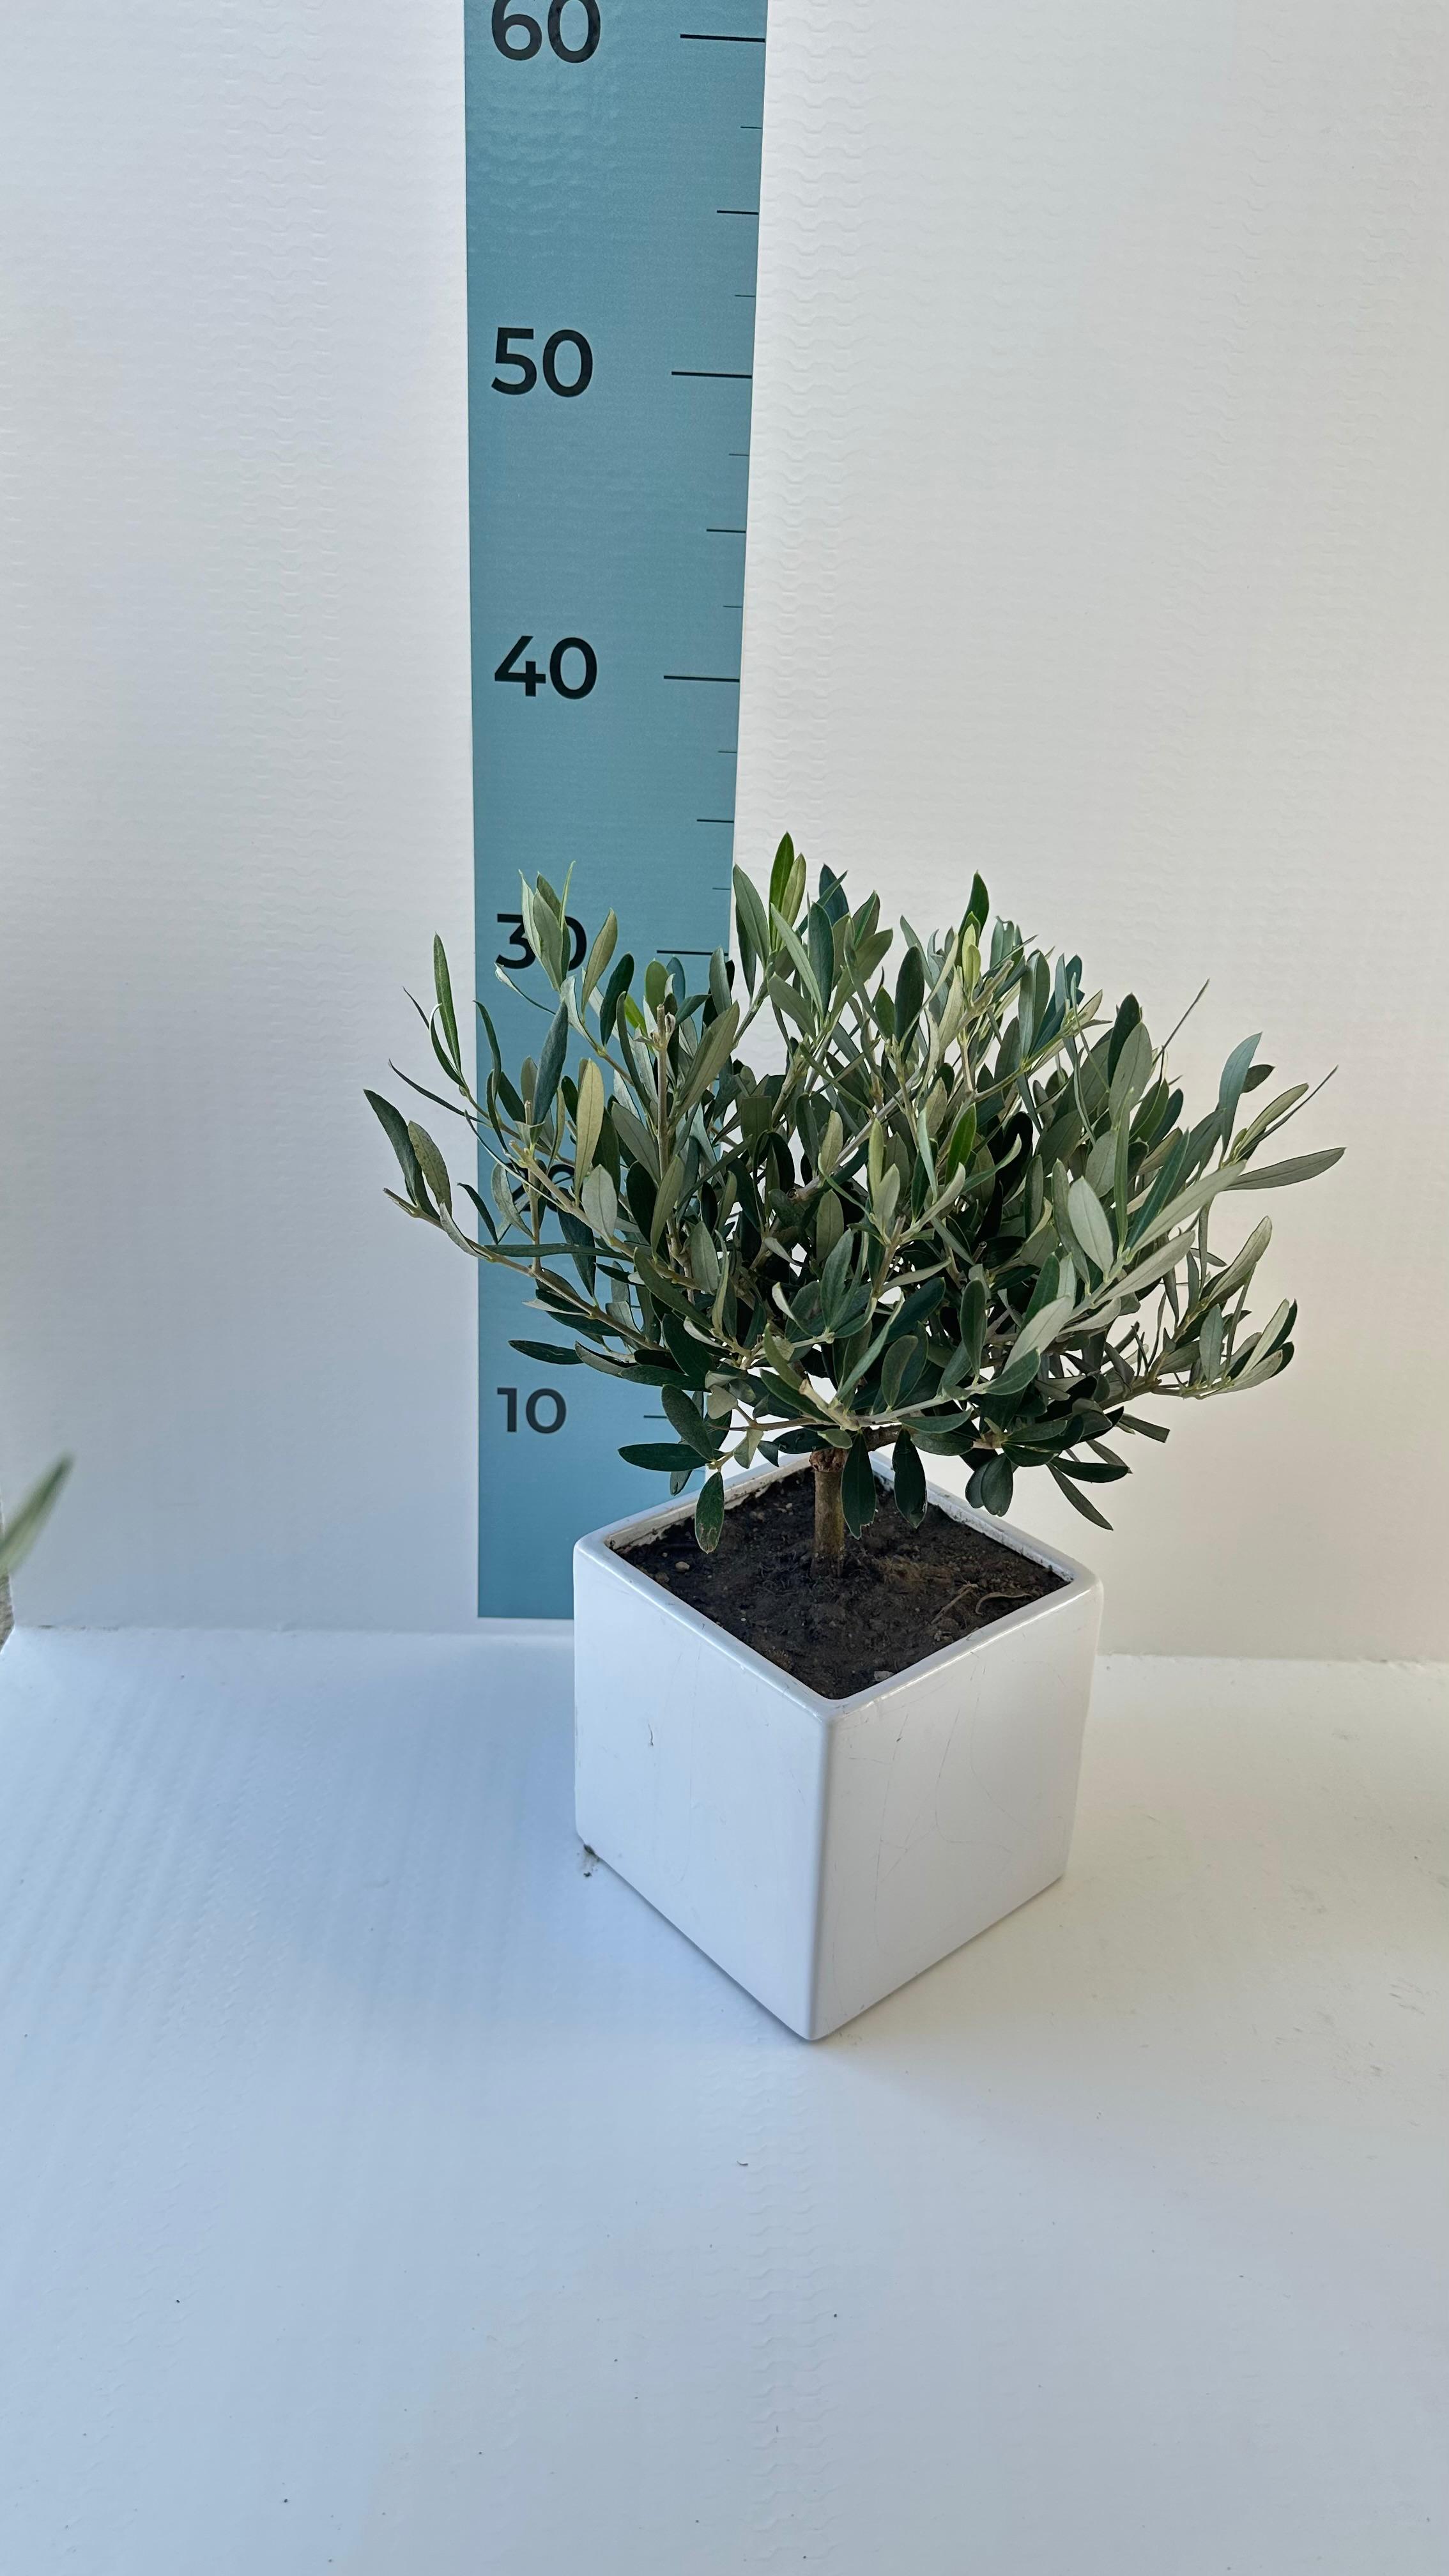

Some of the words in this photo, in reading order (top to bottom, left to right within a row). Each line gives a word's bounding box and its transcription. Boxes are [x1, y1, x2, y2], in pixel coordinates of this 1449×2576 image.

[491, 0, 601, 63] 60
[491, 326, 593, 397] 50
[494, 636, 597, 700] 40
[497, 1388, 567, 1434] 10
